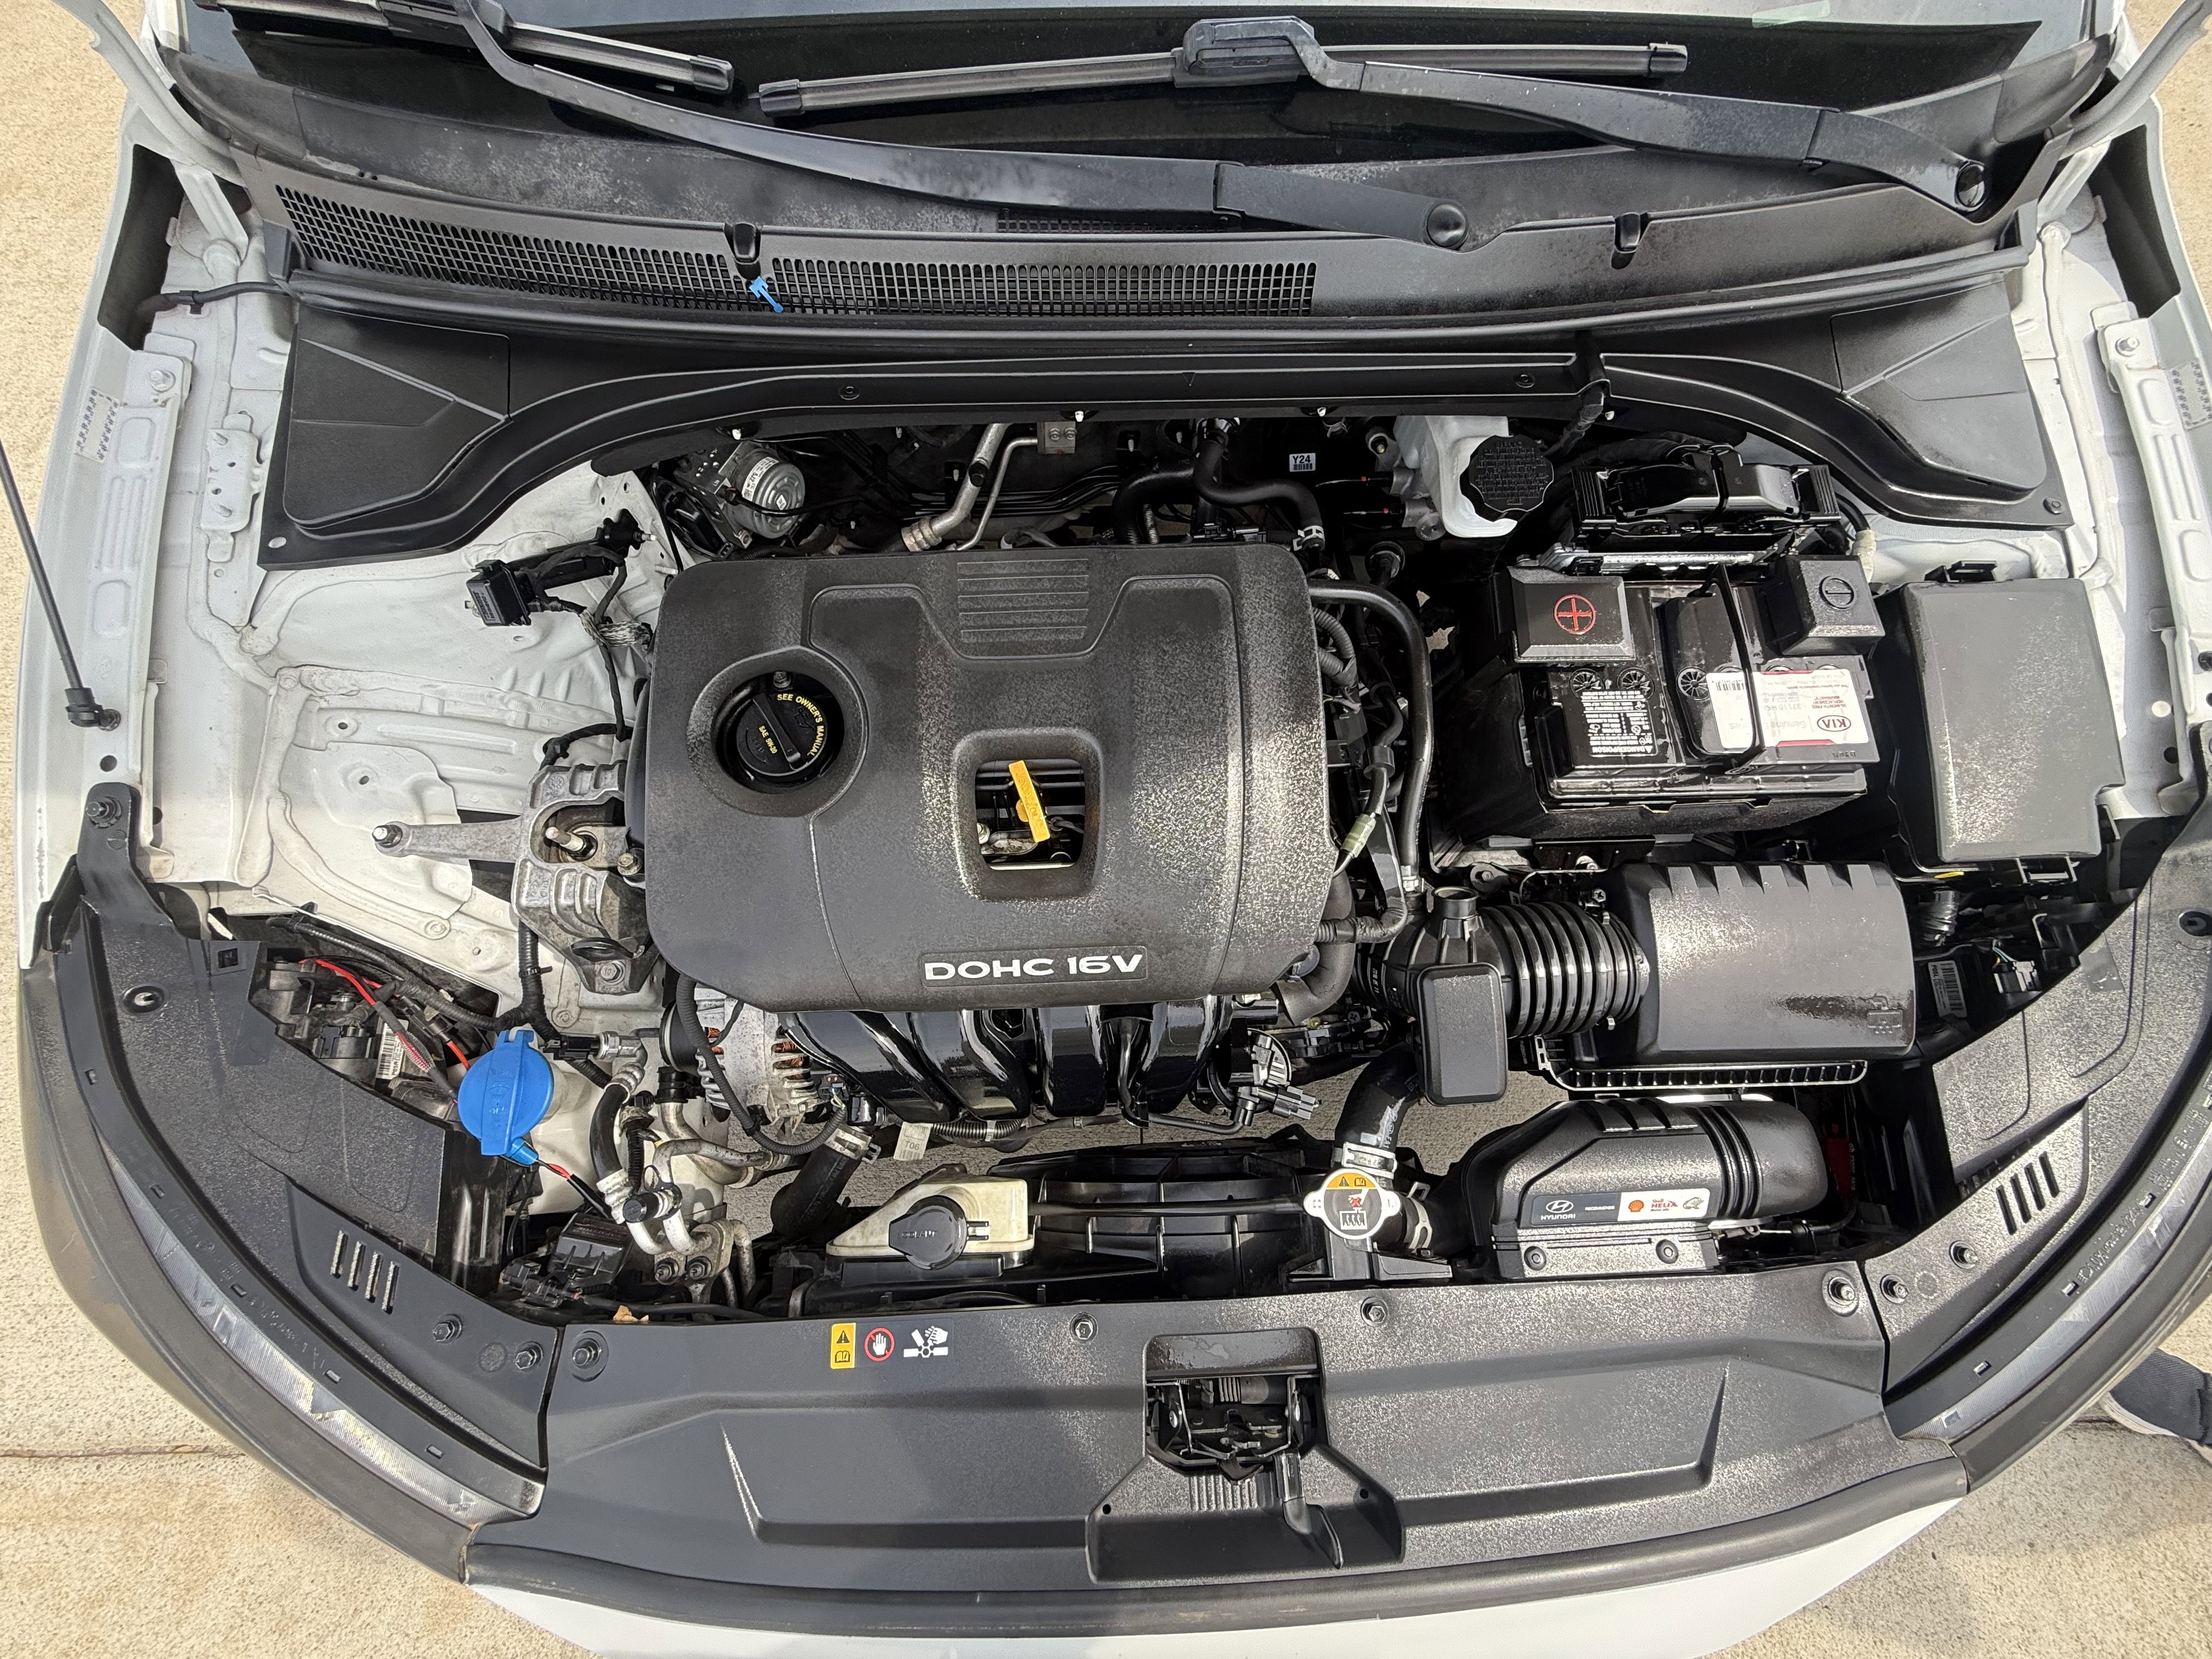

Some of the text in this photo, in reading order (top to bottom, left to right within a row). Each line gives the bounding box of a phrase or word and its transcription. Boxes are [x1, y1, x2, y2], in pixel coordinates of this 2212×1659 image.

[1292, 455, 1311, 464] Y24
[795, 696, 823, 723] OWNER'S
[1770, 720, 1806, 729] Genuine
[1821, 719, 1847, 729] KIA
[759, 726, 778, 754] SAE 5W-20
[806, 725, 824, 757] MANUAL
[924, 953, 1143, 980] DOHC 16V
[905, 1141, 920, 1150] T06
[1651, 1200, 1678, 1208] HELIX
